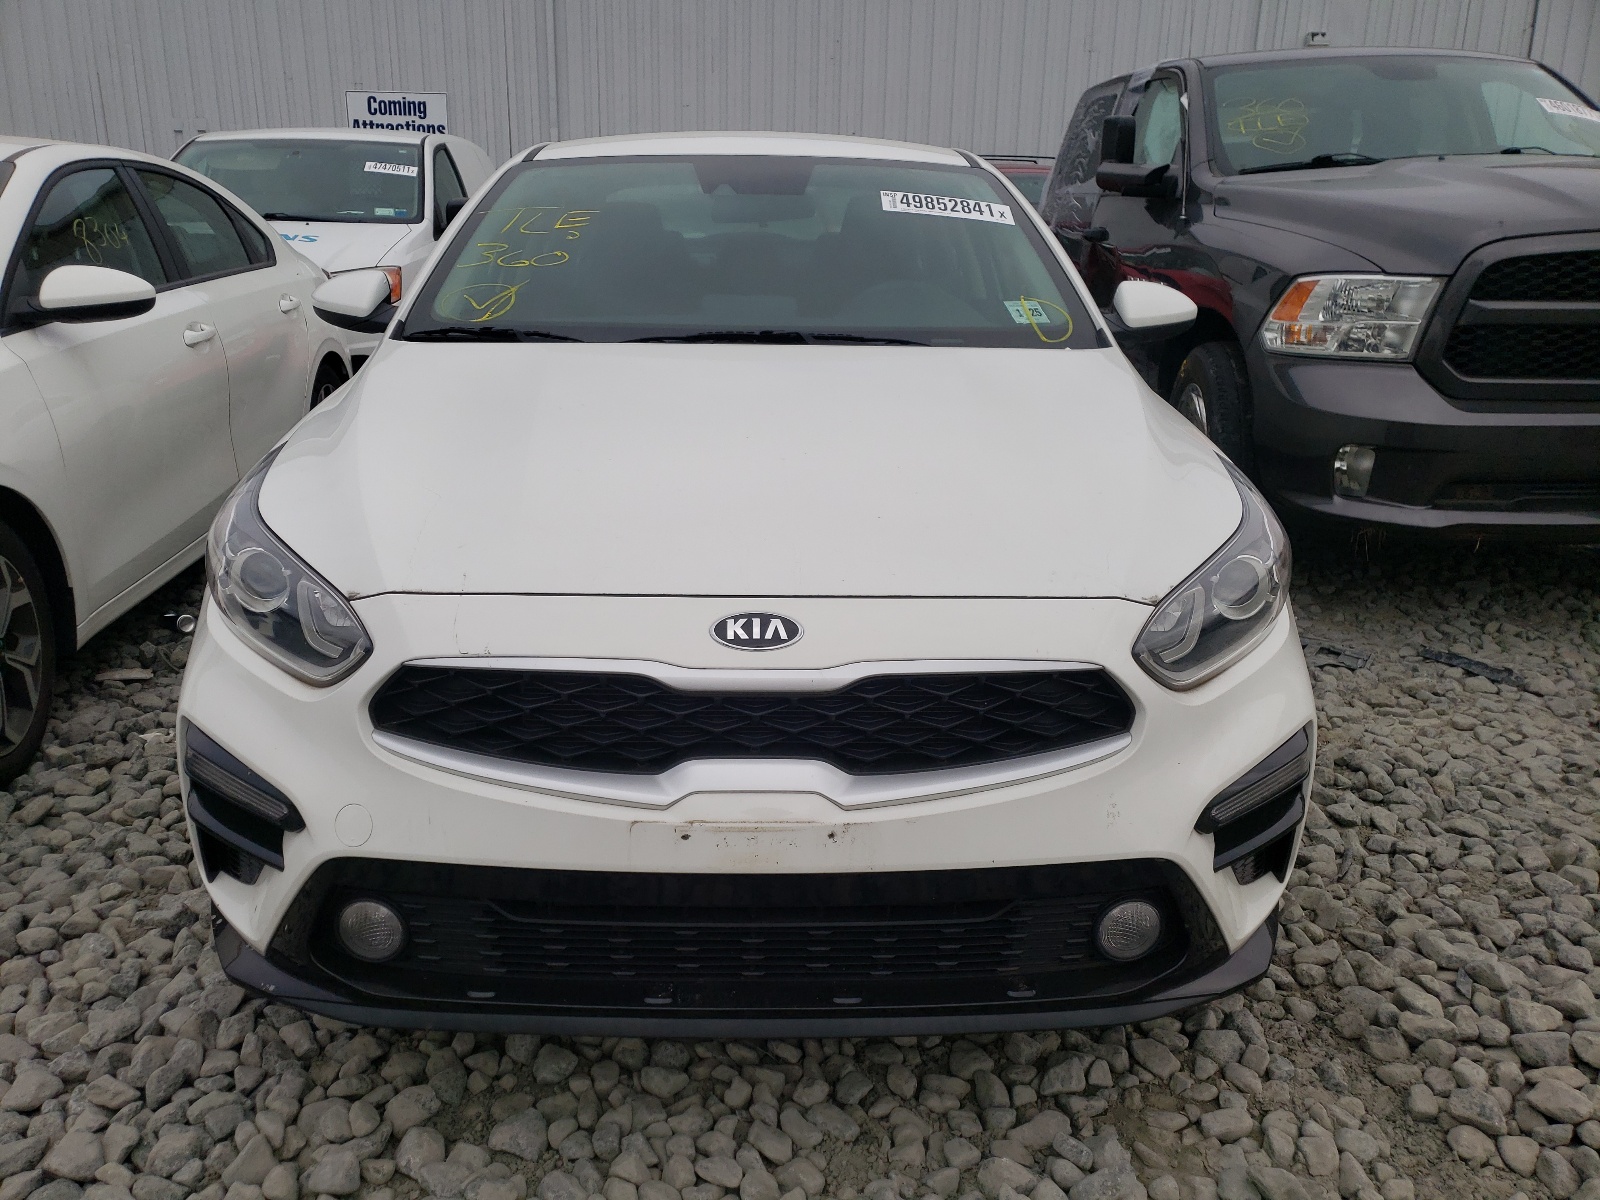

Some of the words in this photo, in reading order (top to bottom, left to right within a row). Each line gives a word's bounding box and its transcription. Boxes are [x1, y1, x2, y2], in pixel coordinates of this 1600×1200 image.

[367, 95, 427, 120] Coming
[456, 243, 570, 267] 360
[725, 617, 789, 640] KIA
